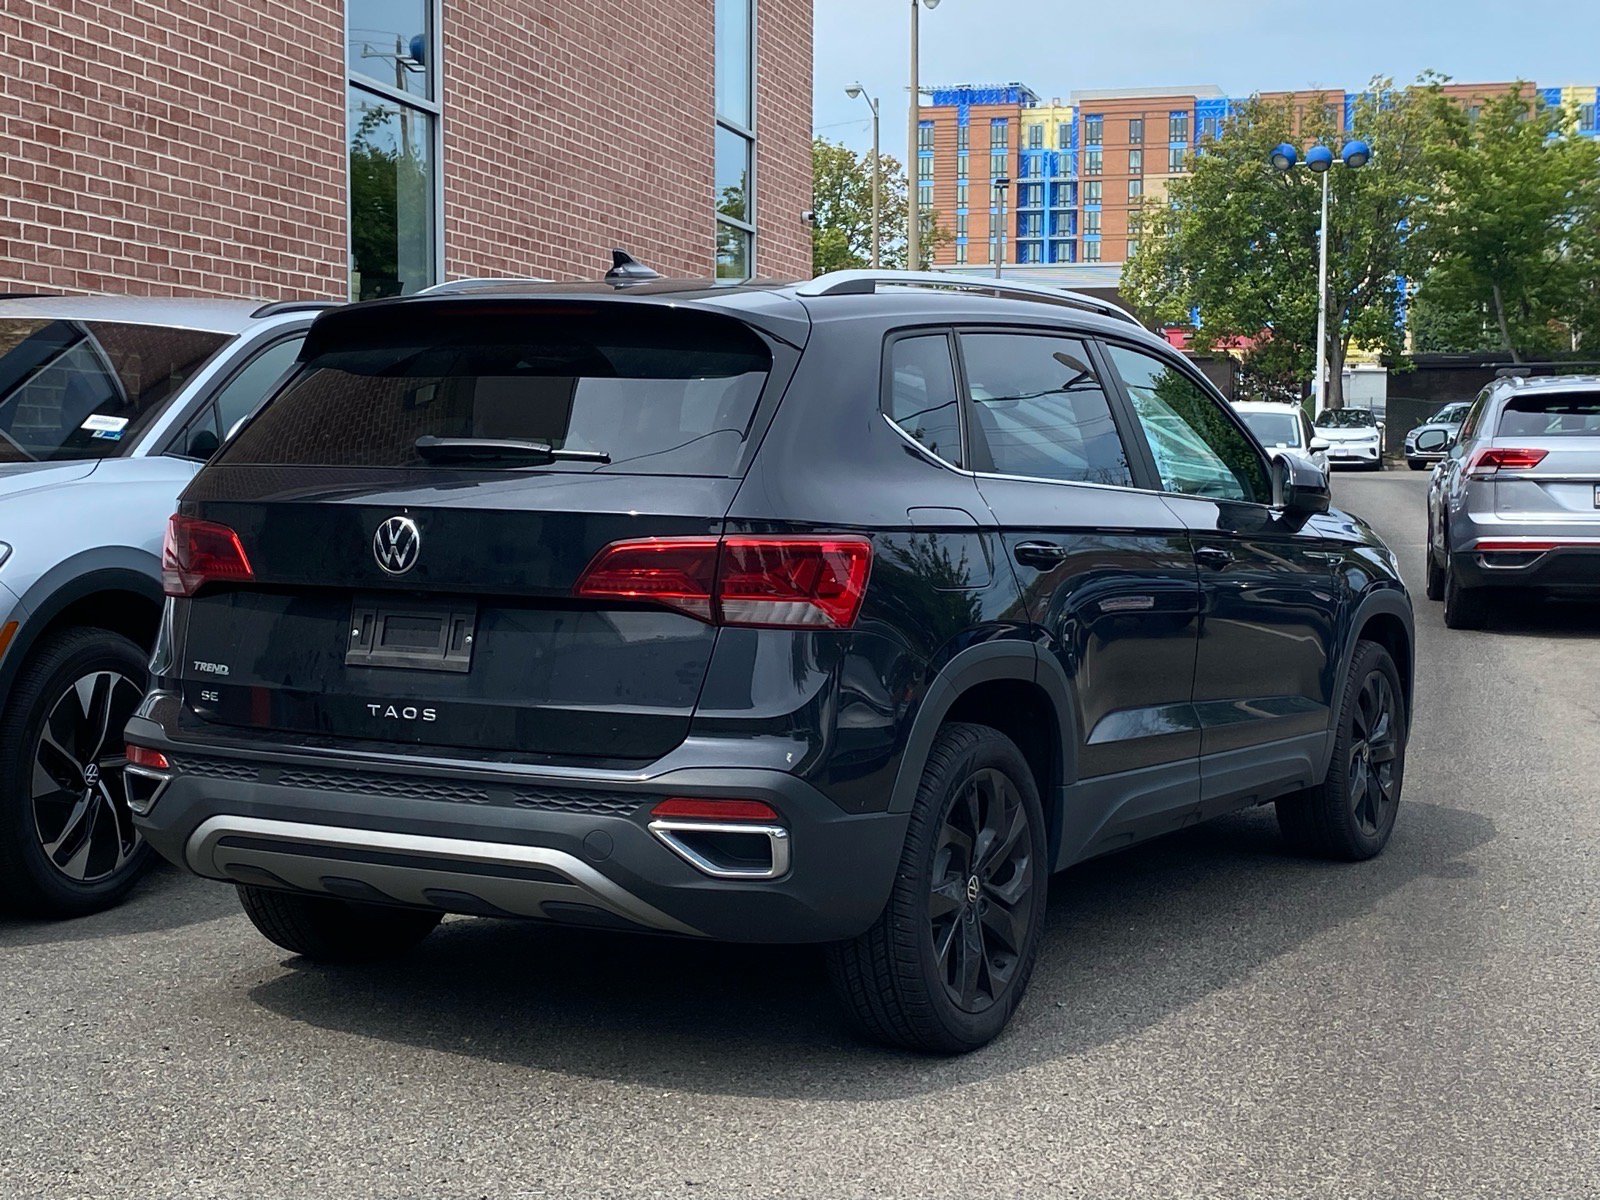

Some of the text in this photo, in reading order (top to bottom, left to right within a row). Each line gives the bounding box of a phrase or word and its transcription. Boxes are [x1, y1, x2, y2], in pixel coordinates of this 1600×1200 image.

[193, 661, 230, 676] TREND
[201, 690, 219, 702] SE
[367, 703, 437, 721] TAOS
